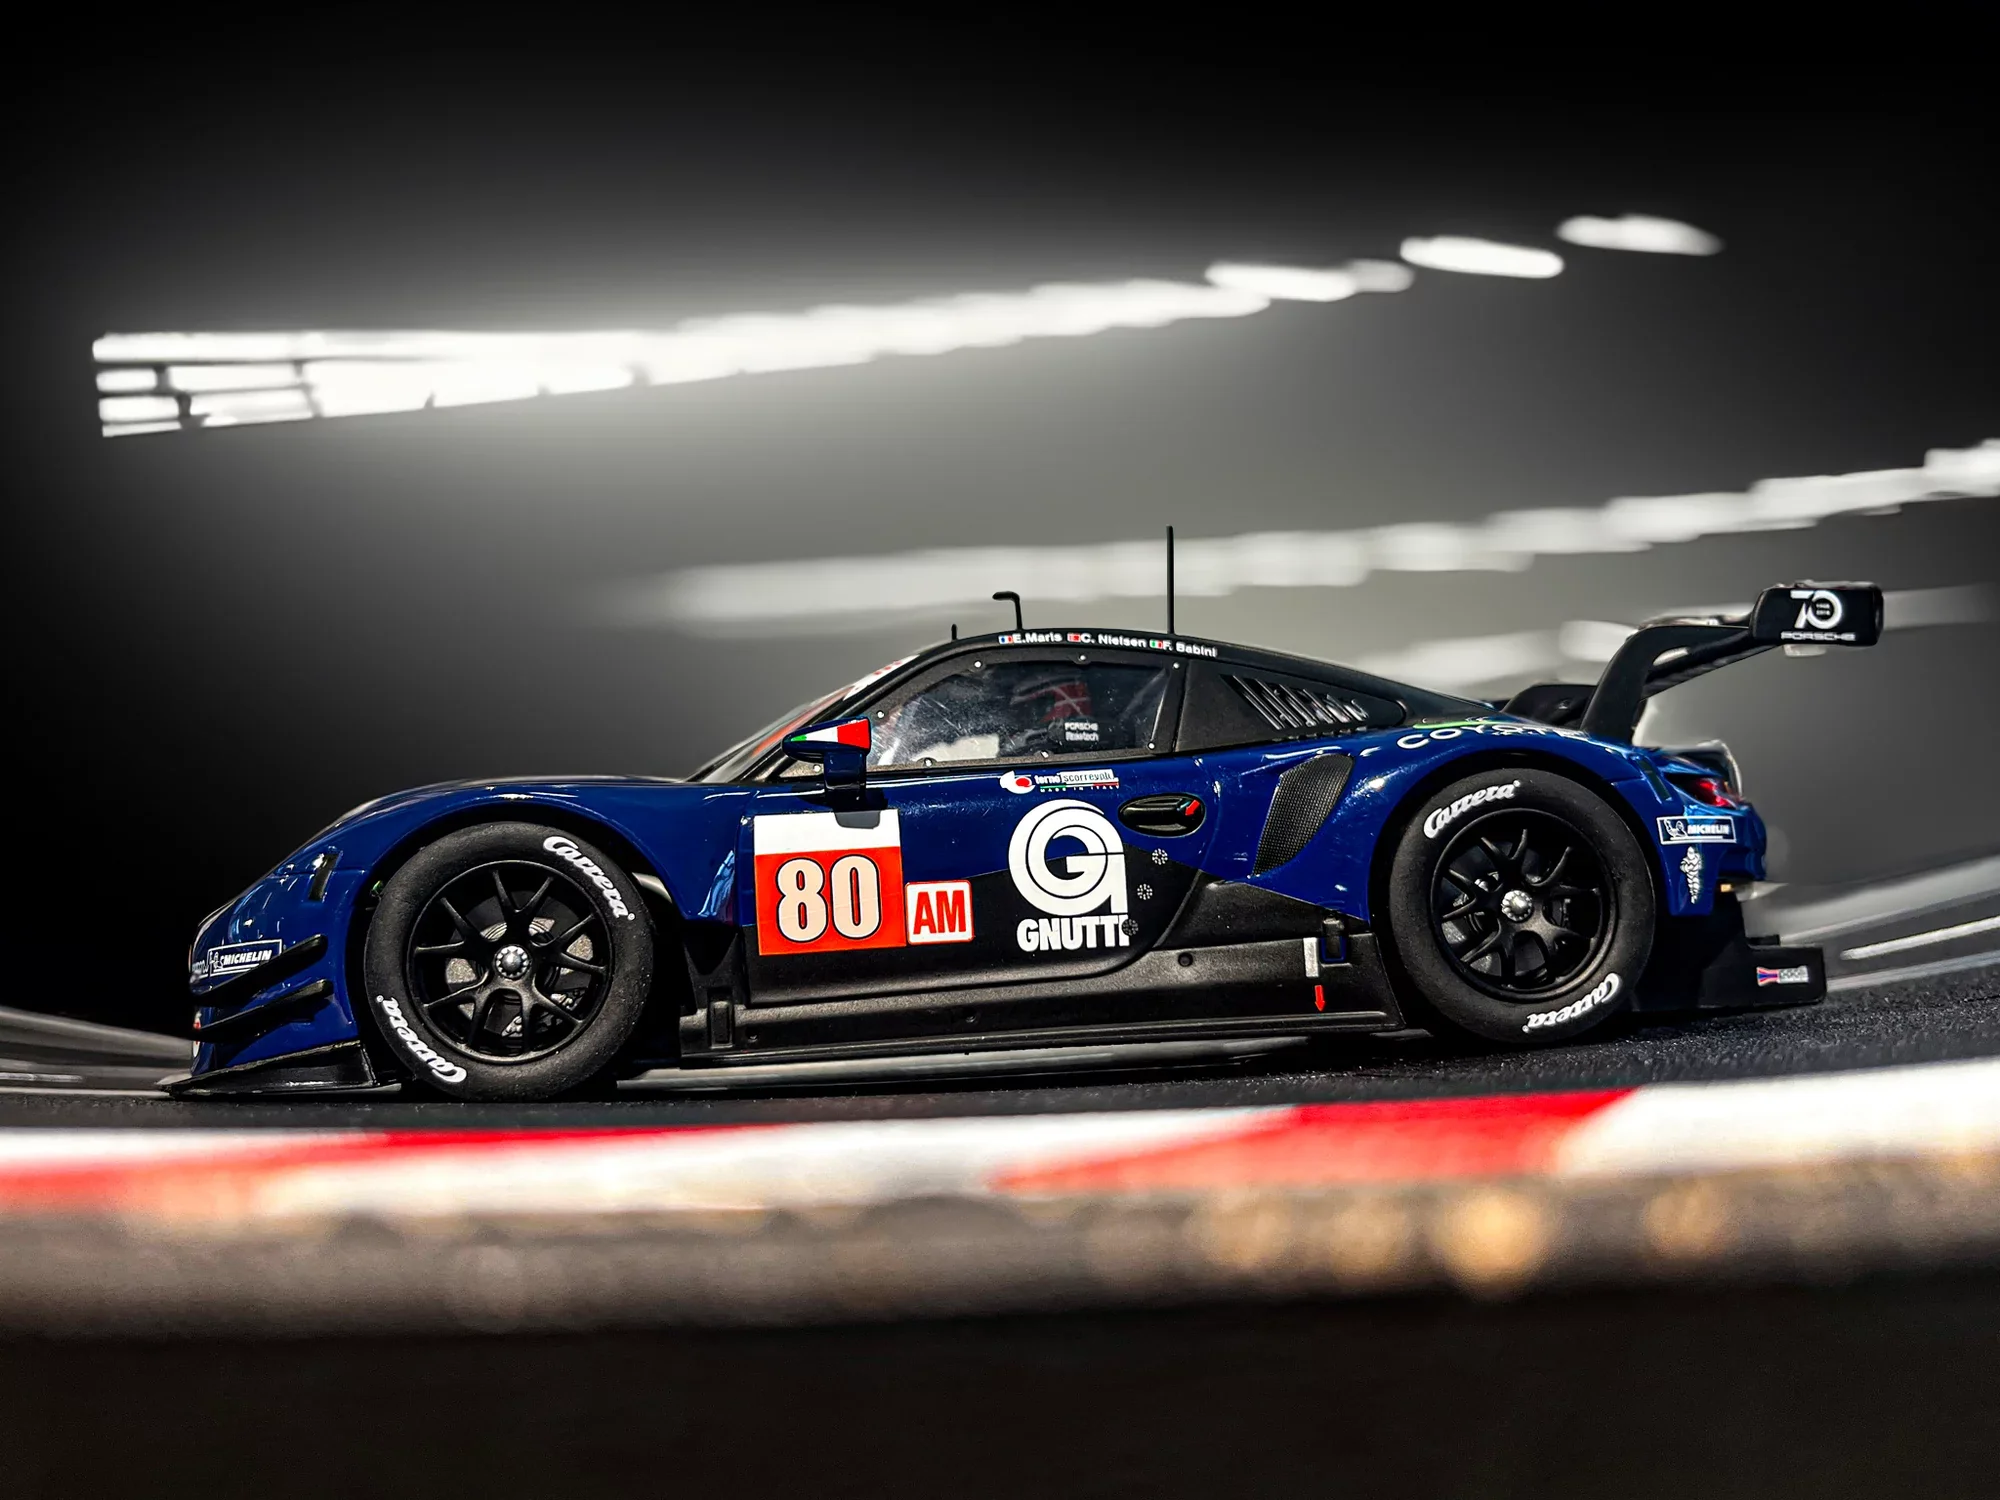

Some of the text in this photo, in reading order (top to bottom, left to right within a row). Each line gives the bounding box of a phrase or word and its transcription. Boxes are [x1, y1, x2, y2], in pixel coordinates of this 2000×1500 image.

[1080, 633, 1096, 643] C.
[1098, 634, 1147, 648] Nielsen
[1176, 642, 1217, 658] Babini
[1424, 783, 1517, 838] Carrera
[1687, 824, 1729, 834] MICHELIN
[543, 836, 629, 919] Carrera
[775, 854, 881, 943] 80
[913, 890, 966, 935] AM
[1017, 914, 1130, 952] GNUTTI
[223, 950, 272, 965] MICHELIN
[1526, 972, 1622, 1029] Carrera
[383, 997, 467, 1083] Carrera
